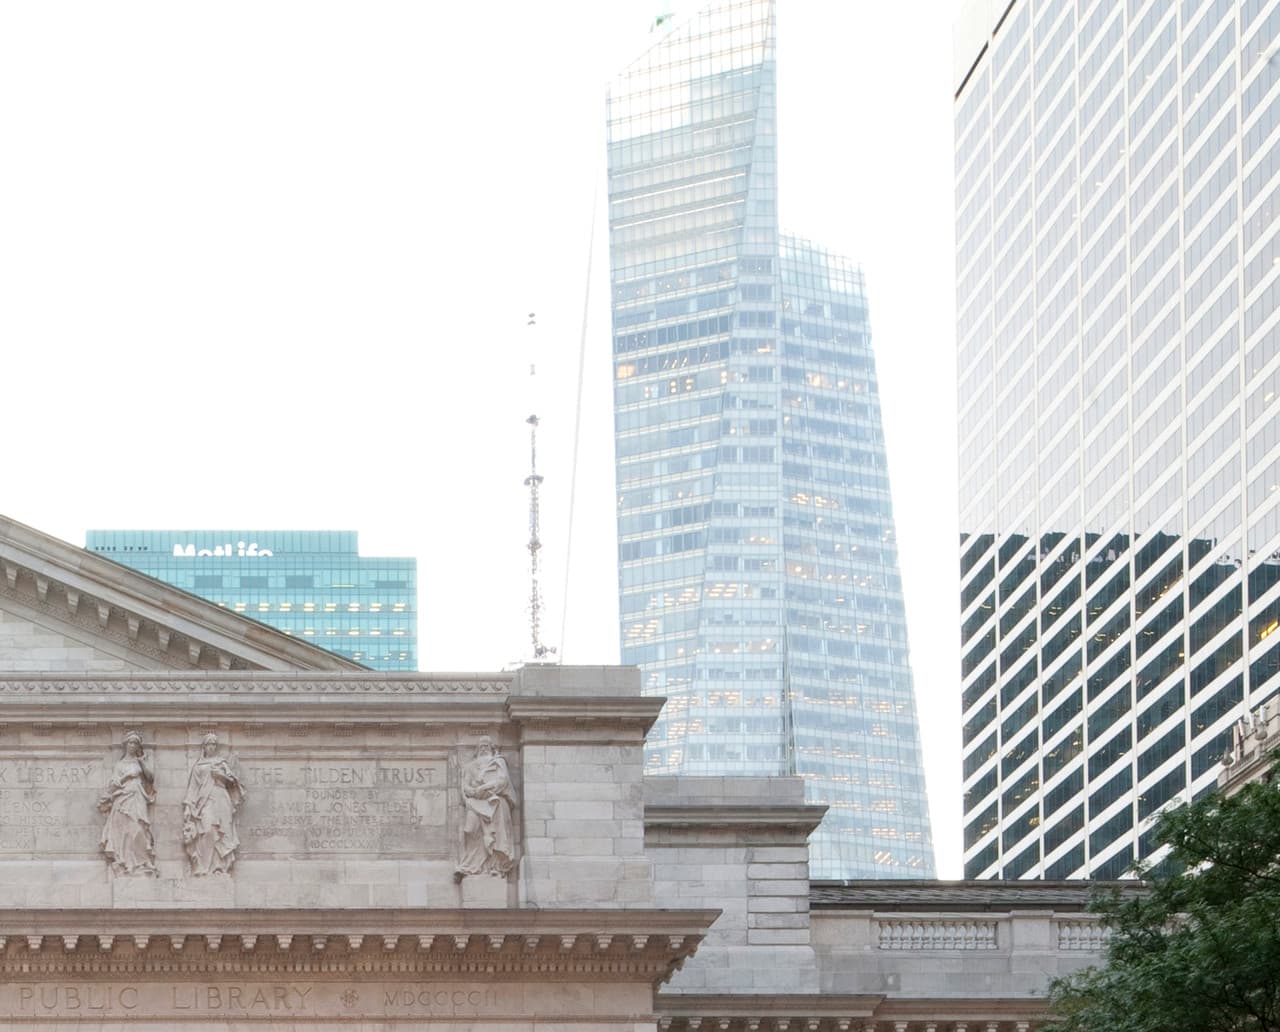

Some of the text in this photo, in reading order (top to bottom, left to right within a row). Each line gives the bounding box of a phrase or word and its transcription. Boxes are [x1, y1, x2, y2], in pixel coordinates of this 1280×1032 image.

[16, 767, 95, 784] LIBRARY
[249, 767, 437, 784] THE TILDEN TRUST
[327, 802, 368, 814] JONES
[19, 986, 141, 1010] PUBLIC
[172, 986, 314, 1010] LIBRARY
